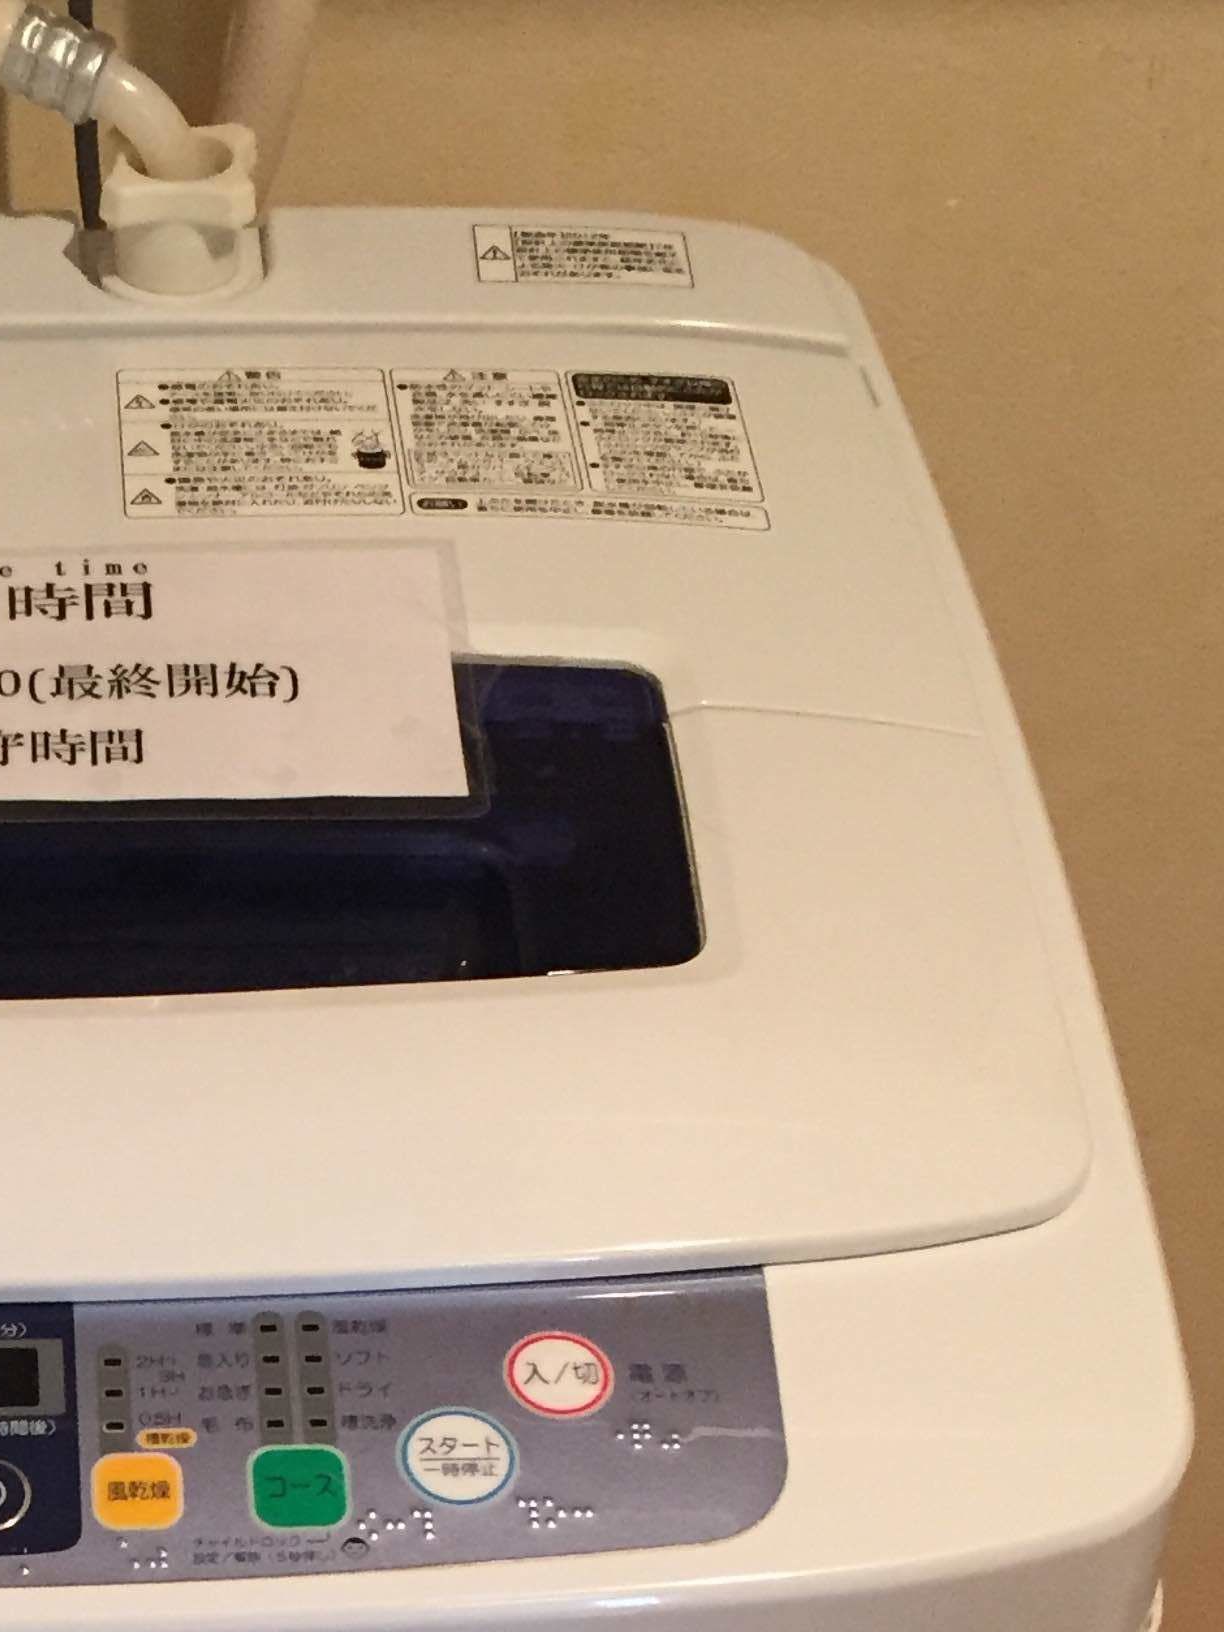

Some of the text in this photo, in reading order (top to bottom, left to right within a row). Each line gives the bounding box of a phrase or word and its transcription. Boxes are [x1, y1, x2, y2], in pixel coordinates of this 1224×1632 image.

[54, 560, 148, 577] time
[336, 1351, 390, 1366] ソフト
[339, 1382, 393, 1398] ドライ
[419, 1436, 500, 1455] スタート
[423, 1463, 498, 1478] 一時停止
[108, 1480, 170, 1501] 風乾燥
[265, 1474, 337, 1498] コース
